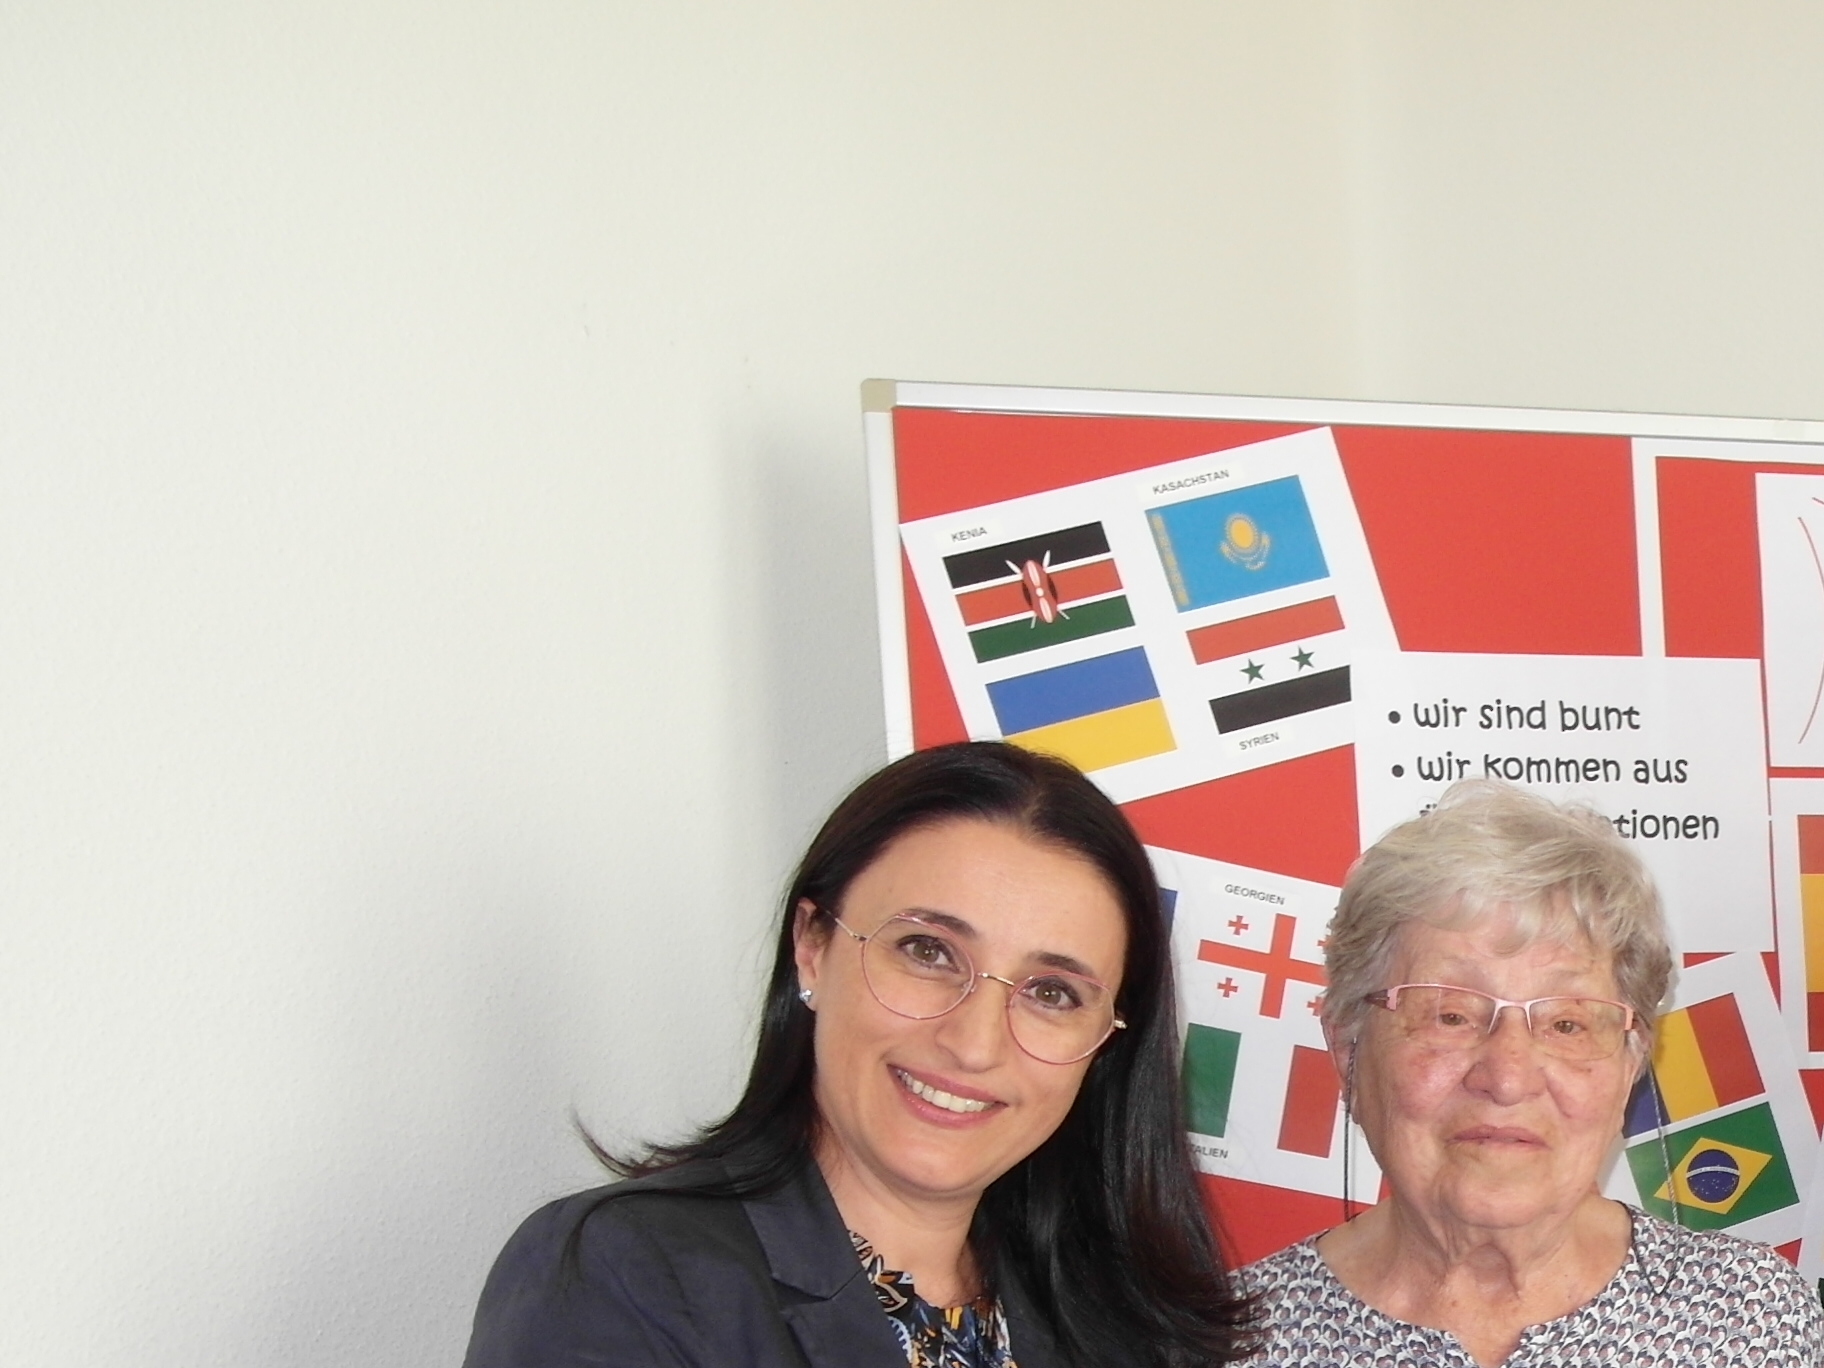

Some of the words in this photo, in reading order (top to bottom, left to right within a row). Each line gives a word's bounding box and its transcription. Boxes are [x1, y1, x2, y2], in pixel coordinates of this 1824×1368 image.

[1151, 469, 1230, 496] KASACHSTAN
[950, 526, 988, 543] KENIA
[1413, 701, 1468, 731] wir
[1478, 700, 1547, 732] sind
[1558, 701, 1642, 733] bunt
[1238, 732, 1280, 751] SYRIEN
[1416, 754, 1471, 783] wir
[1483, 754, 1620, 784] kommen
[1632, 756, 1688, 785] aus
[1598, 807, 1720, 840] tionen
[1223, 883, 1285, 906] GEORGIEN
[1189, 1142, 1229, 1159] TALIEN
